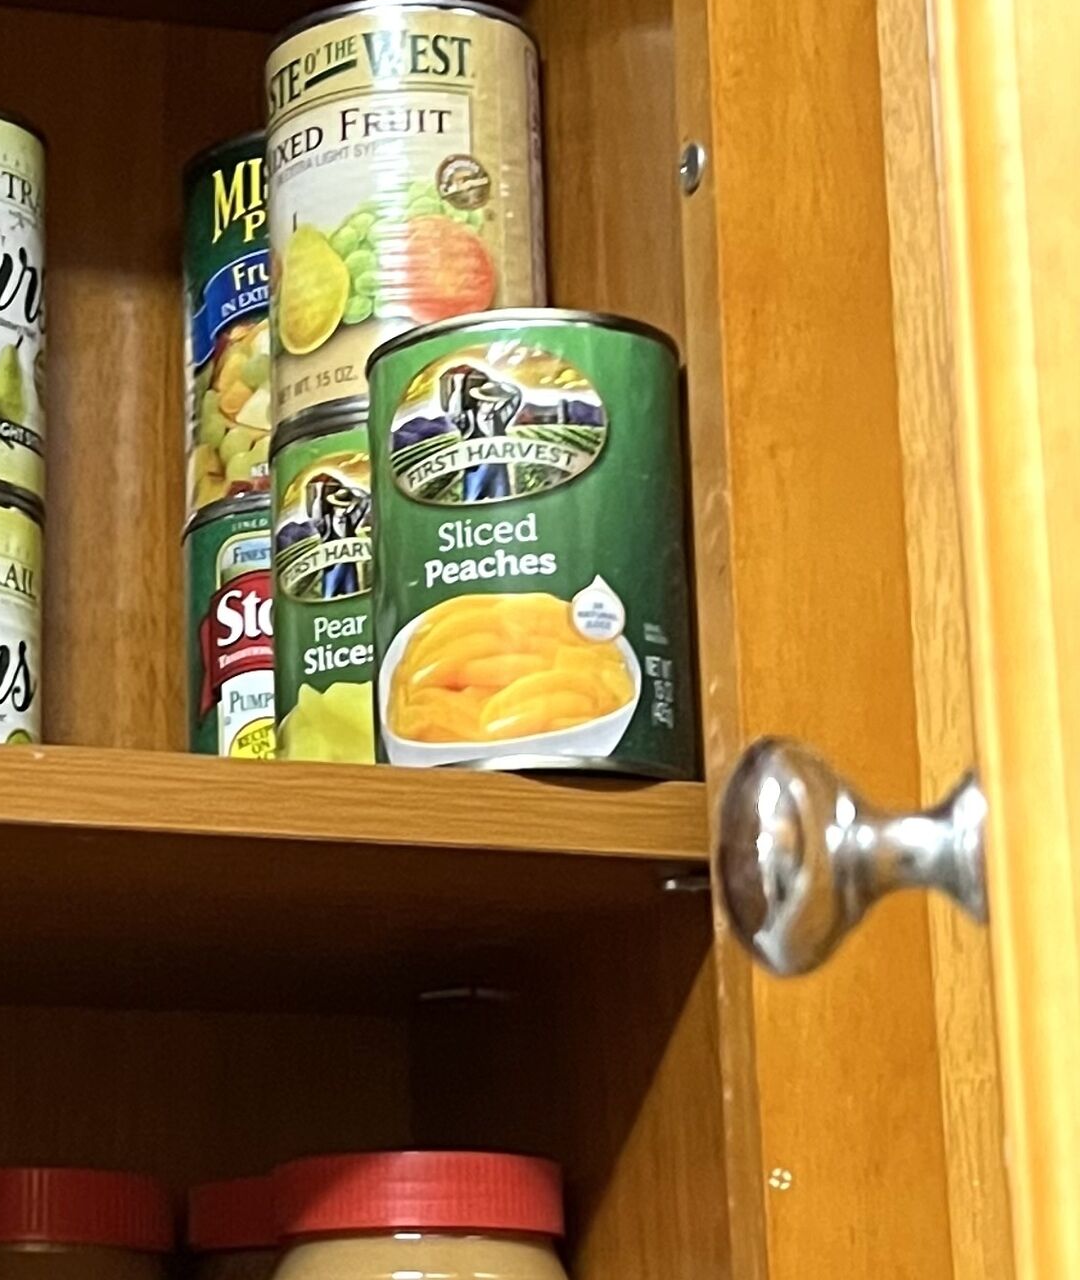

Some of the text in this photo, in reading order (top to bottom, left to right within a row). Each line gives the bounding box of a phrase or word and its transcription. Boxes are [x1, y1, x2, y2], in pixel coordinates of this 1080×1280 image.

[324, 36, 357, 65] THE
[407, 440, 579, 489] FIRST HARVEST
[437, 512, 539, 553] Sliced
[424, 549, 558, 589] Peaches
[314, 615, 368, 642] Pear
